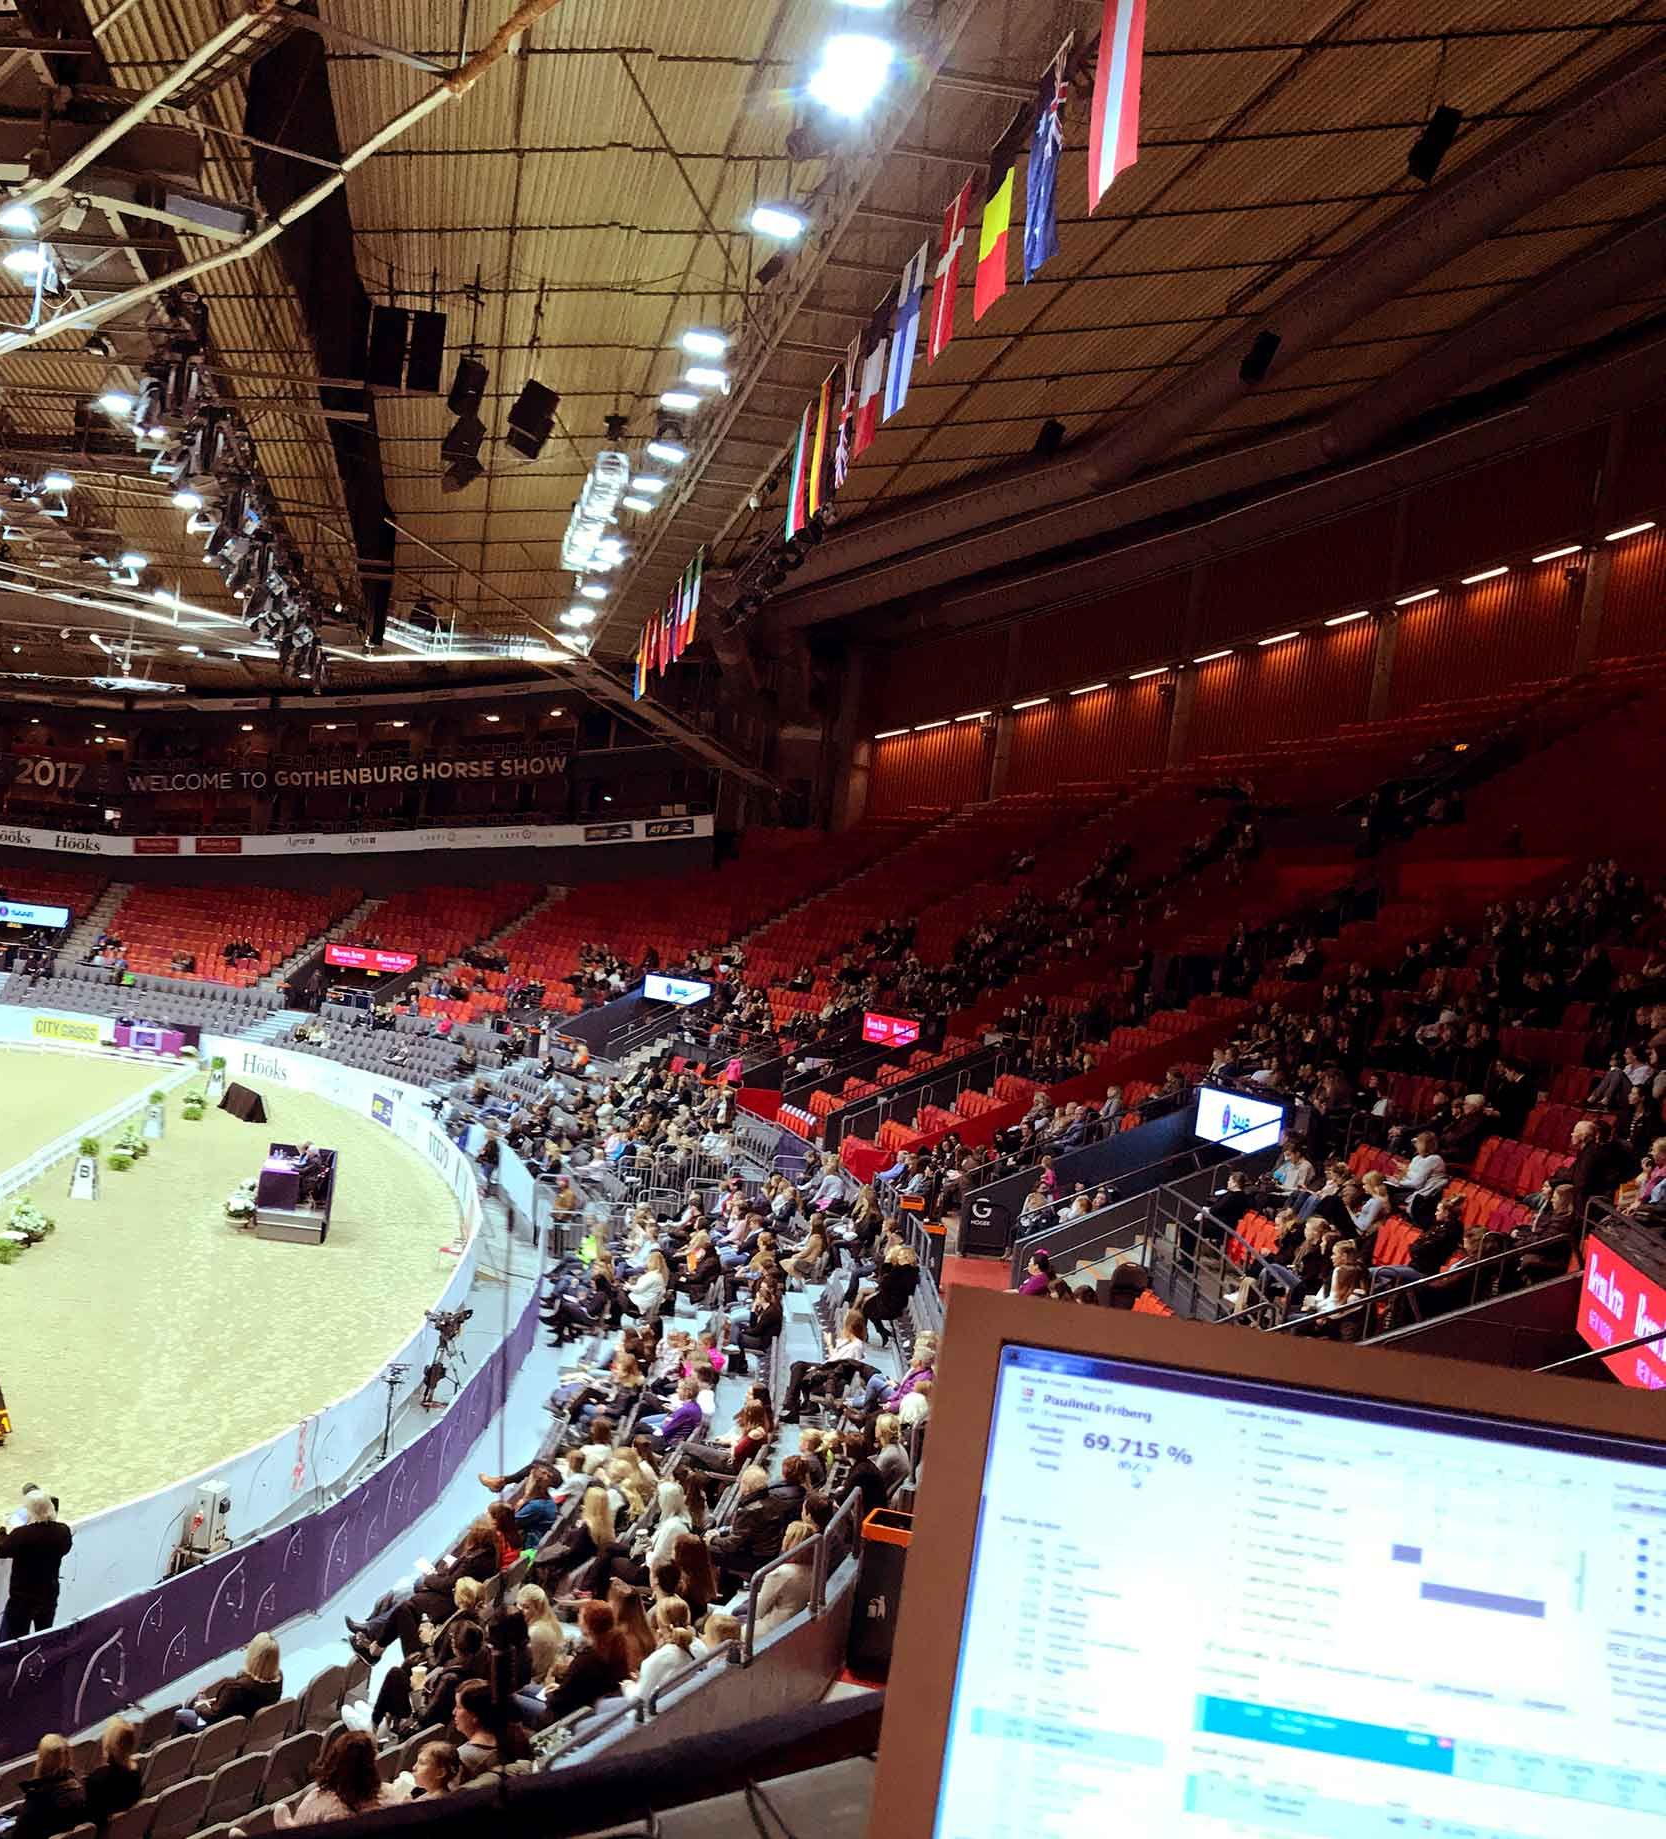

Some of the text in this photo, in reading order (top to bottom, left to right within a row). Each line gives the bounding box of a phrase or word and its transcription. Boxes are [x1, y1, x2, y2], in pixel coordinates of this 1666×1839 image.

[17, 760, 84, 788] 2017
[127, 756, 567, 793] WELCOME TO GOTHENBURG HORSE SHOW
[35, 1019, 97, 1040] CITY CROSS
[80, 1164, 89, 1178] B
[972, 1199, 992, 1218] G
[1043, 1393, 1101, 1415] Paulinda
[1104, 1403, 1153, 1424] Friberg
[1, 1416, 12, 1433] 1
[1082, 1432, 1161, 1460] 69.715
[1166, 1445, 1194, 1466] %
